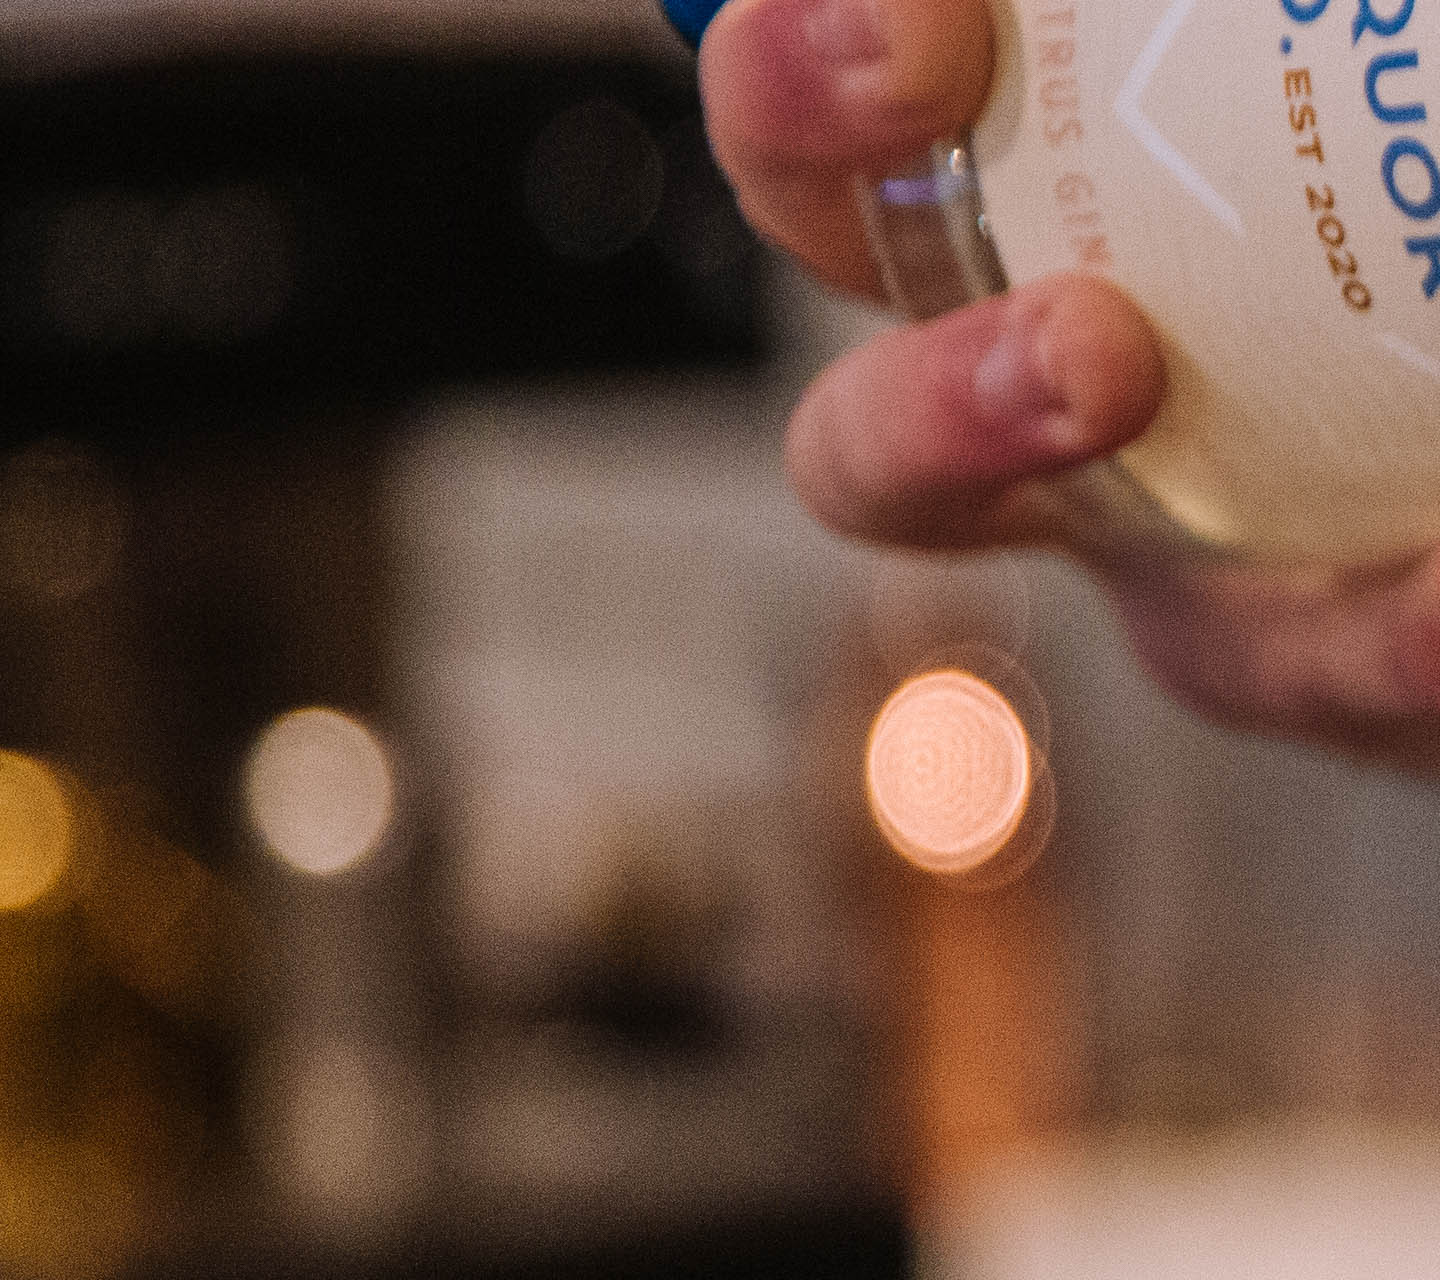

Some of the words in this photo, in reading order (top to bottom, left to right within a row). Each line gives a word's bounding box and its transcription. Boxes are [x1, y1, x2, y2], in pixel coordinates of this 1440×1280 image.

[1053, 172, 1114, 269] GIN
[1283, 68, 1324, 164] EST
[1305, 183, 1372, 314] 2020
